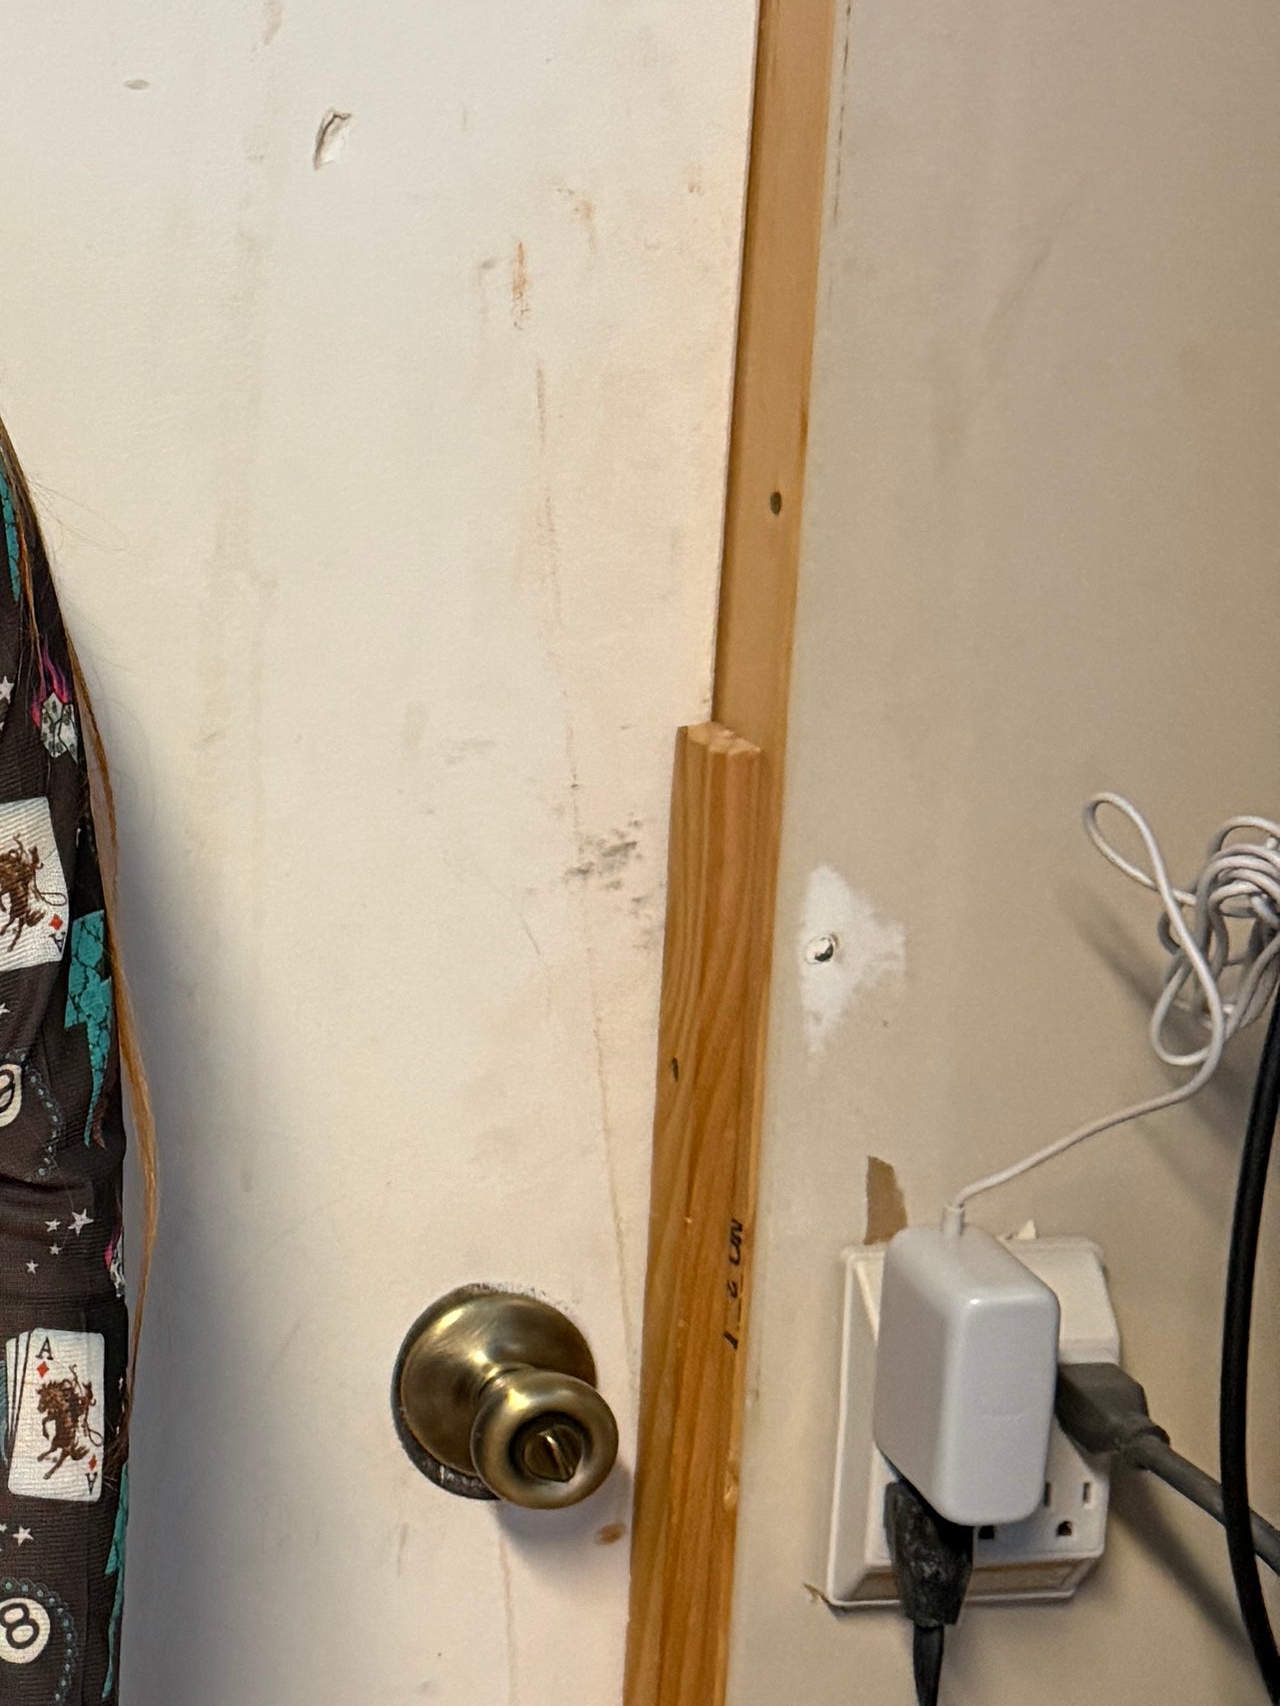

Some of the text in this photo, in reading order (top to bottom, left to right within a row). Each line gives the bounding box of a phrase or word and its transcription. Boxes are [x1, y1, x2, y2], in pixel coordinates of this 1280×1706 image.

[49, 932, 65, 953] A
[35, 1337, 54, 1360] A
[85, 1472, 98, 1494] A
